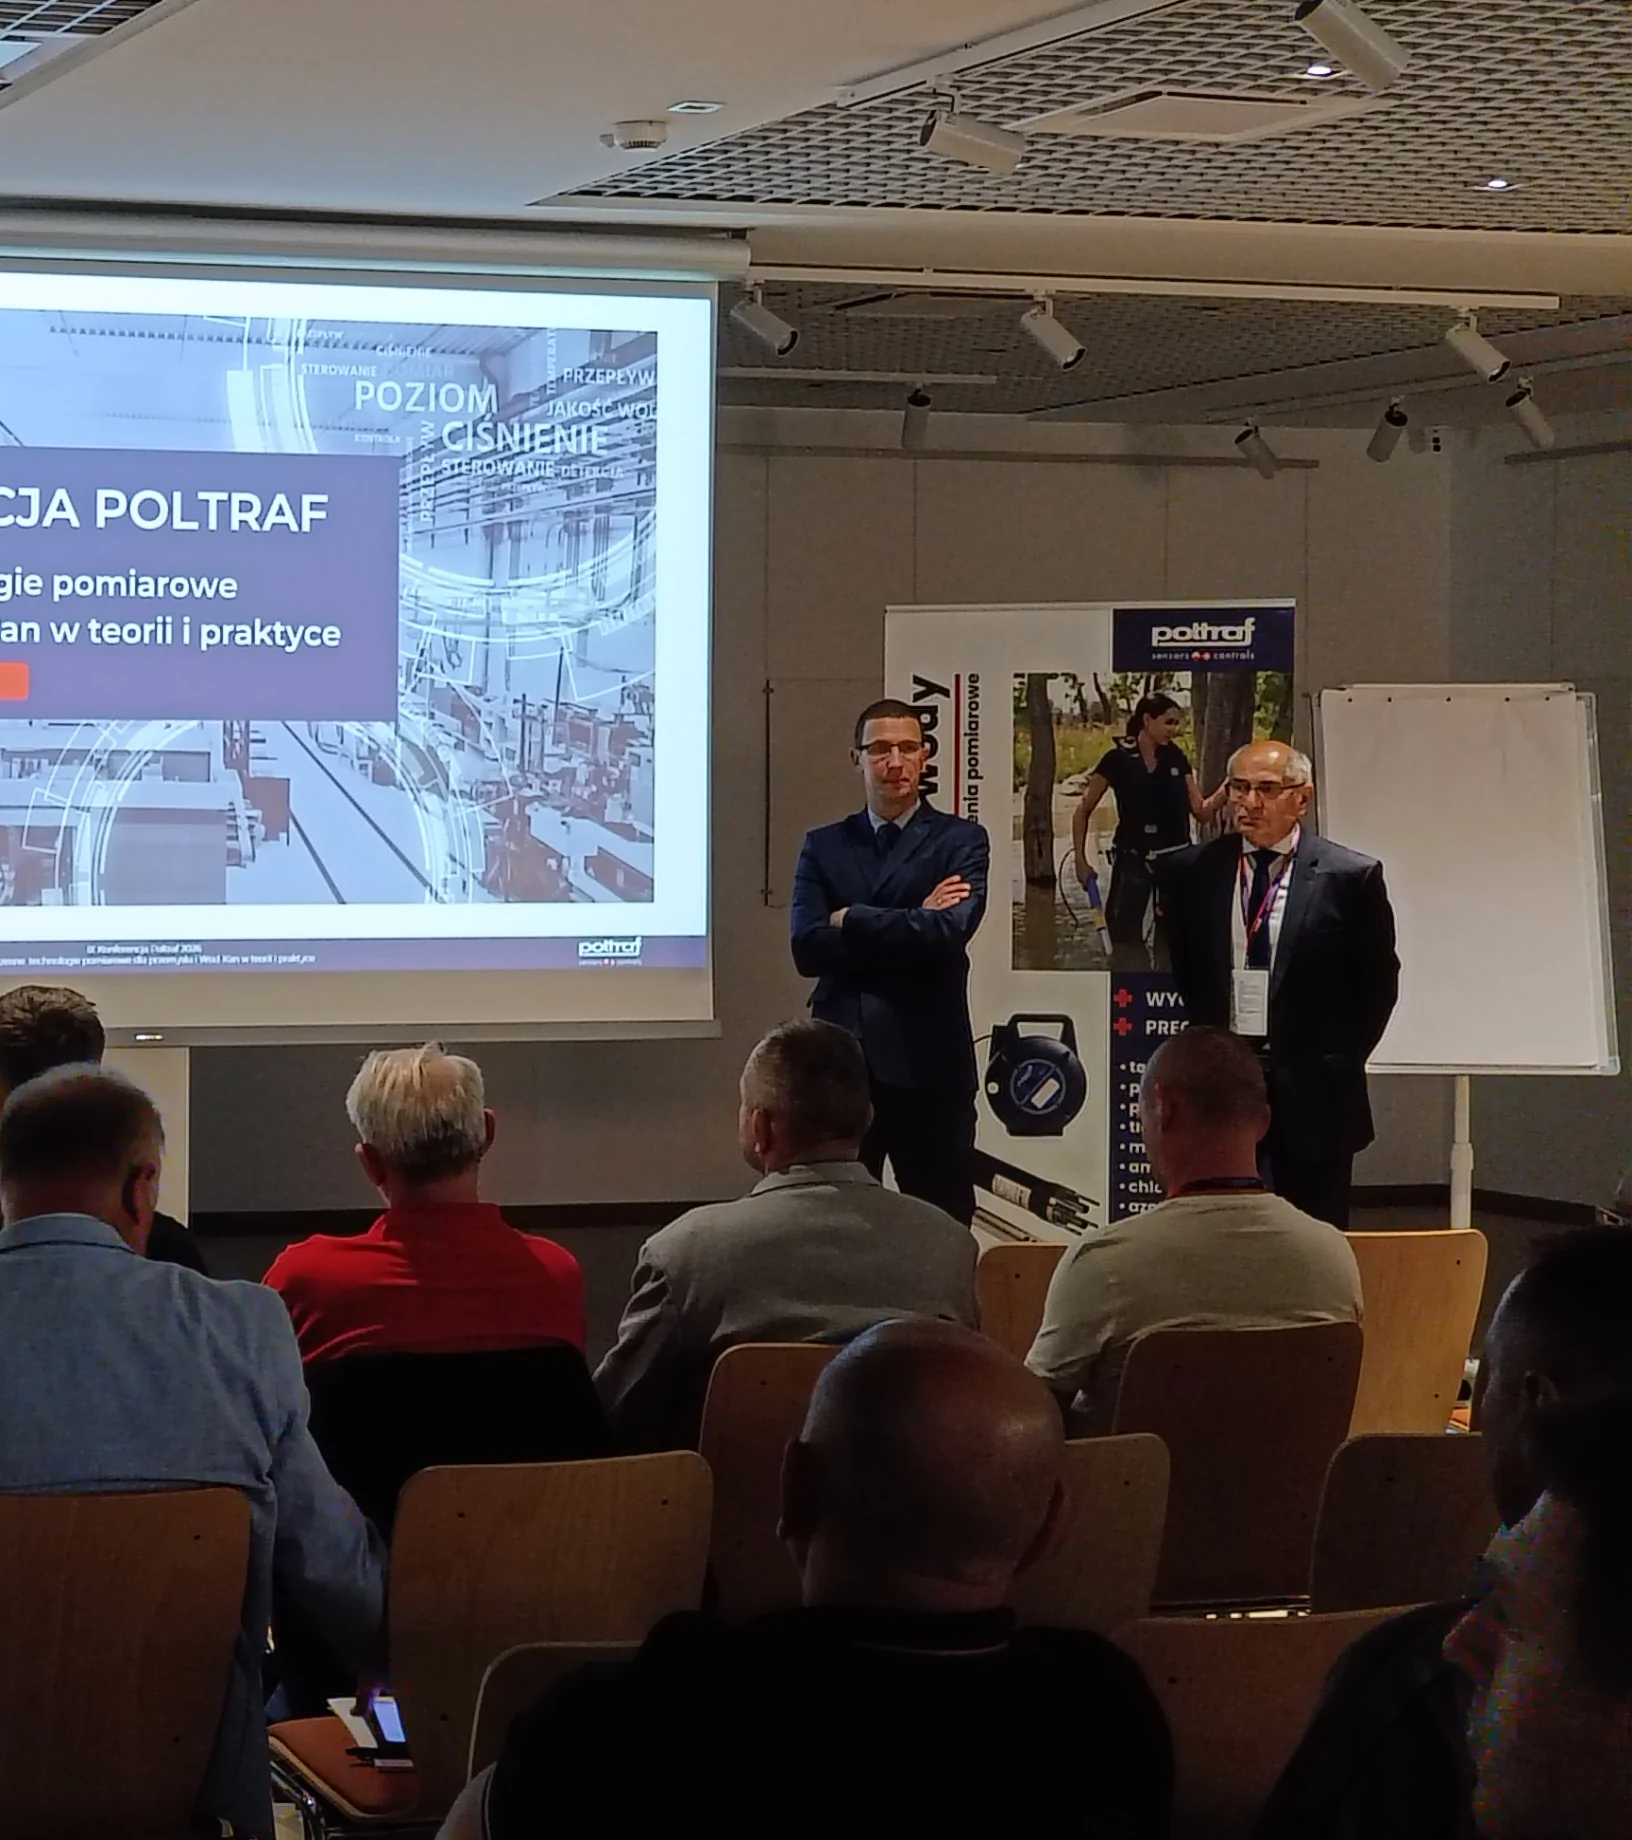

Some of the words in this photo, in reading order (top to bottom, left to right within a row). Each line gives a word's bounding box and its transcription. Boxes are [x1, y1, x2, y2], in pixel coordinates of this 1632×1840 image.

[300, 363, 378, 378] STEROWANIE
[562, 367, 656, 387] PRZEPŁYW
[354, 380, 499, 415] POZIOM
[546, 397, 613, 418] JAKOŚĆ
[441, 412, 609, 456] CIŚNIENIE
[419, 420, 436, 524] PRZEPŁYW
[441, 458, 556, 478] STEROWANIE
[95, 488, 329, 533] POLTRAF
[53, 568, 238, 602] pomiarowe
[49, 620, 81, 644] w
[87, 615, 173, 646] teorii
[182, 616, 191, 646] i
[200, 618, 342, 653] praktyce
[1151, 616, 1256, 647] poltraf
[963, 673, 984, 780] pomiarowe
